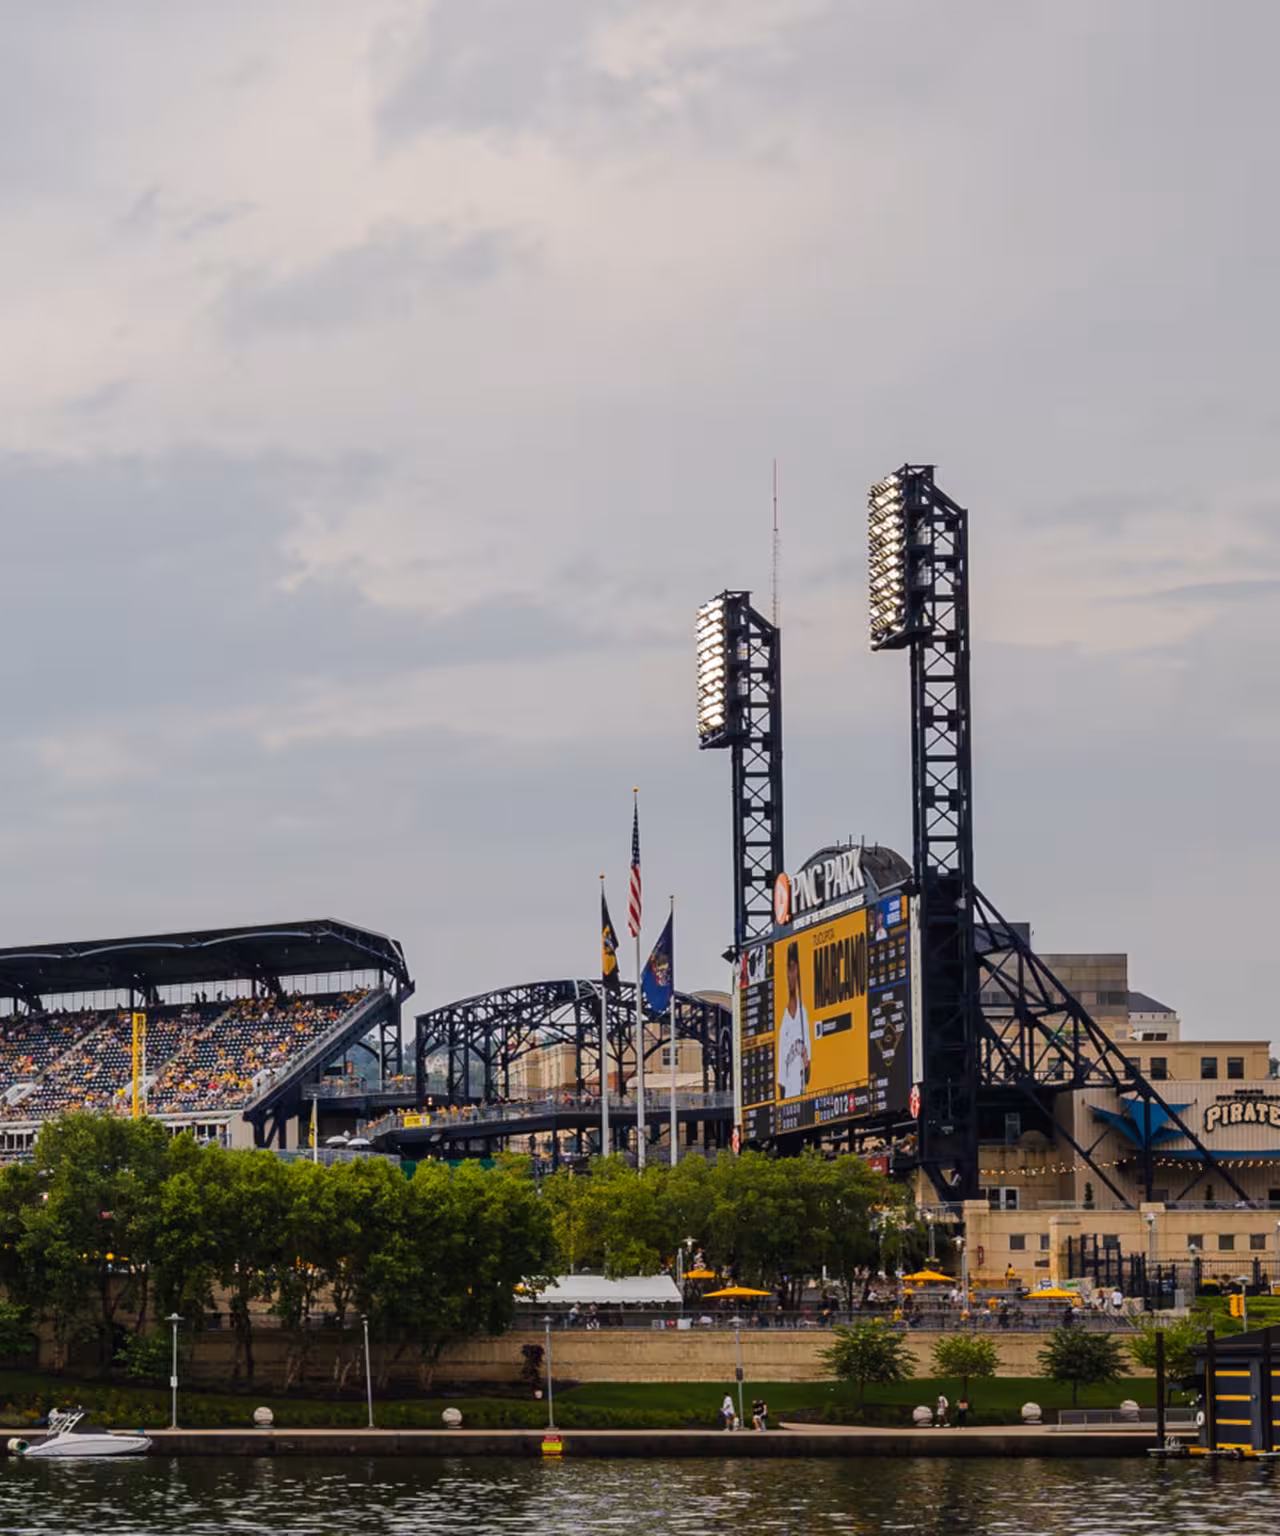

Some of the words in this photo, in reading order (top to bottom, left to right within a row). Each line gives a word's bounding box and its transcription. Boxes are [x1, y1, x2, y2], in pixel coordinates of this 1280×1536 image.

[791, 864, 823, 914] PNC
[824, 847, 865, 901] PARK
[814, 932, 865, 1010] MARCANO
